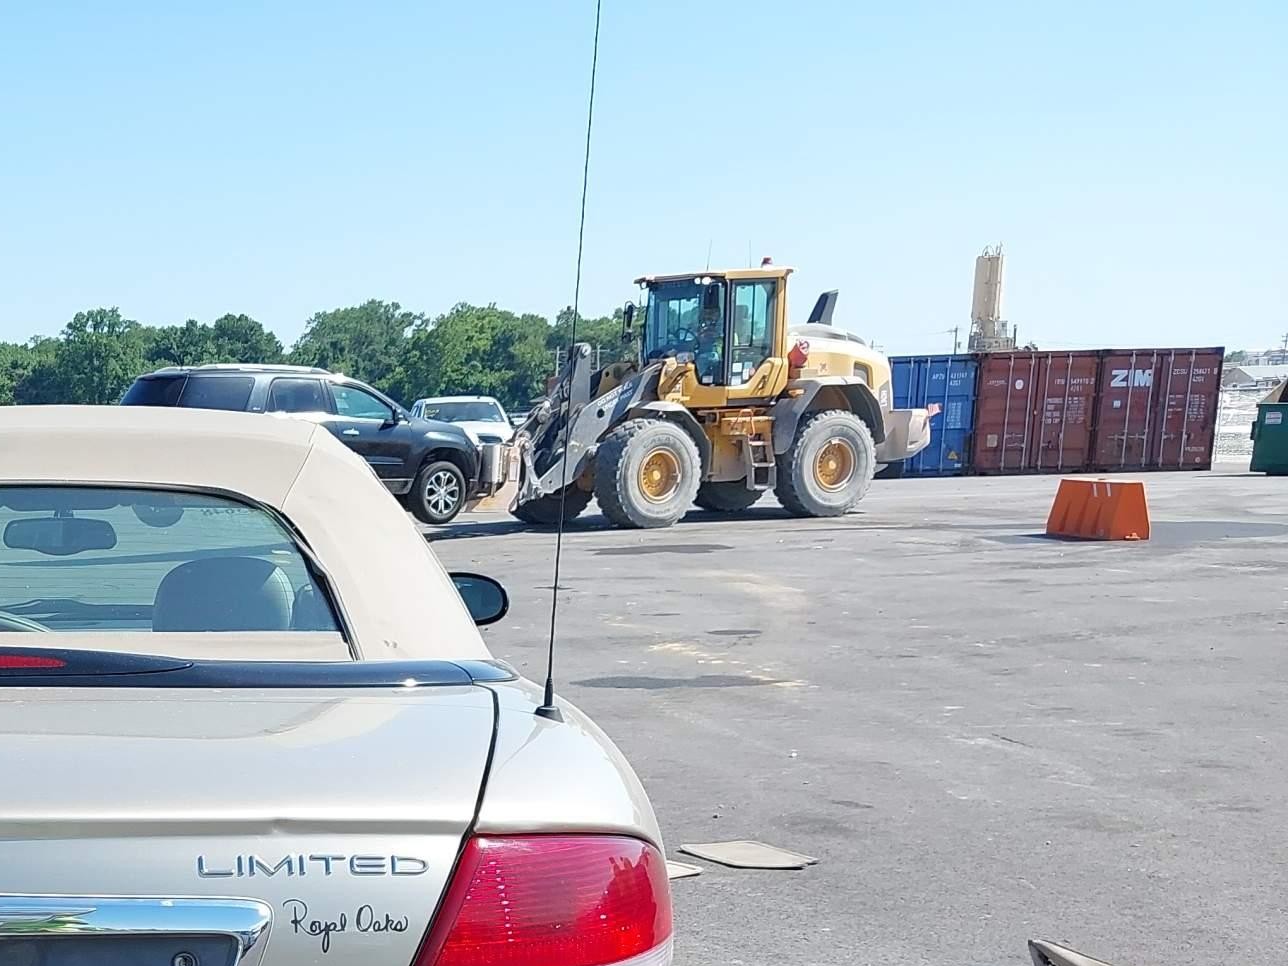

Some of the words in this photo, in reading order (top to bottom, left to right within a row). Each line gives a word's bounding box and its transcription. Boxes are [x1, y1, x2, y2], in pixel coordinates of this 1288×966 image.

[1110, 369, 1153, 387] ZIM
[197, 854, 430, 878] LIMITED
[283, 899, 348, 953] Royal
[356, 904, 410, 932] Oaks
